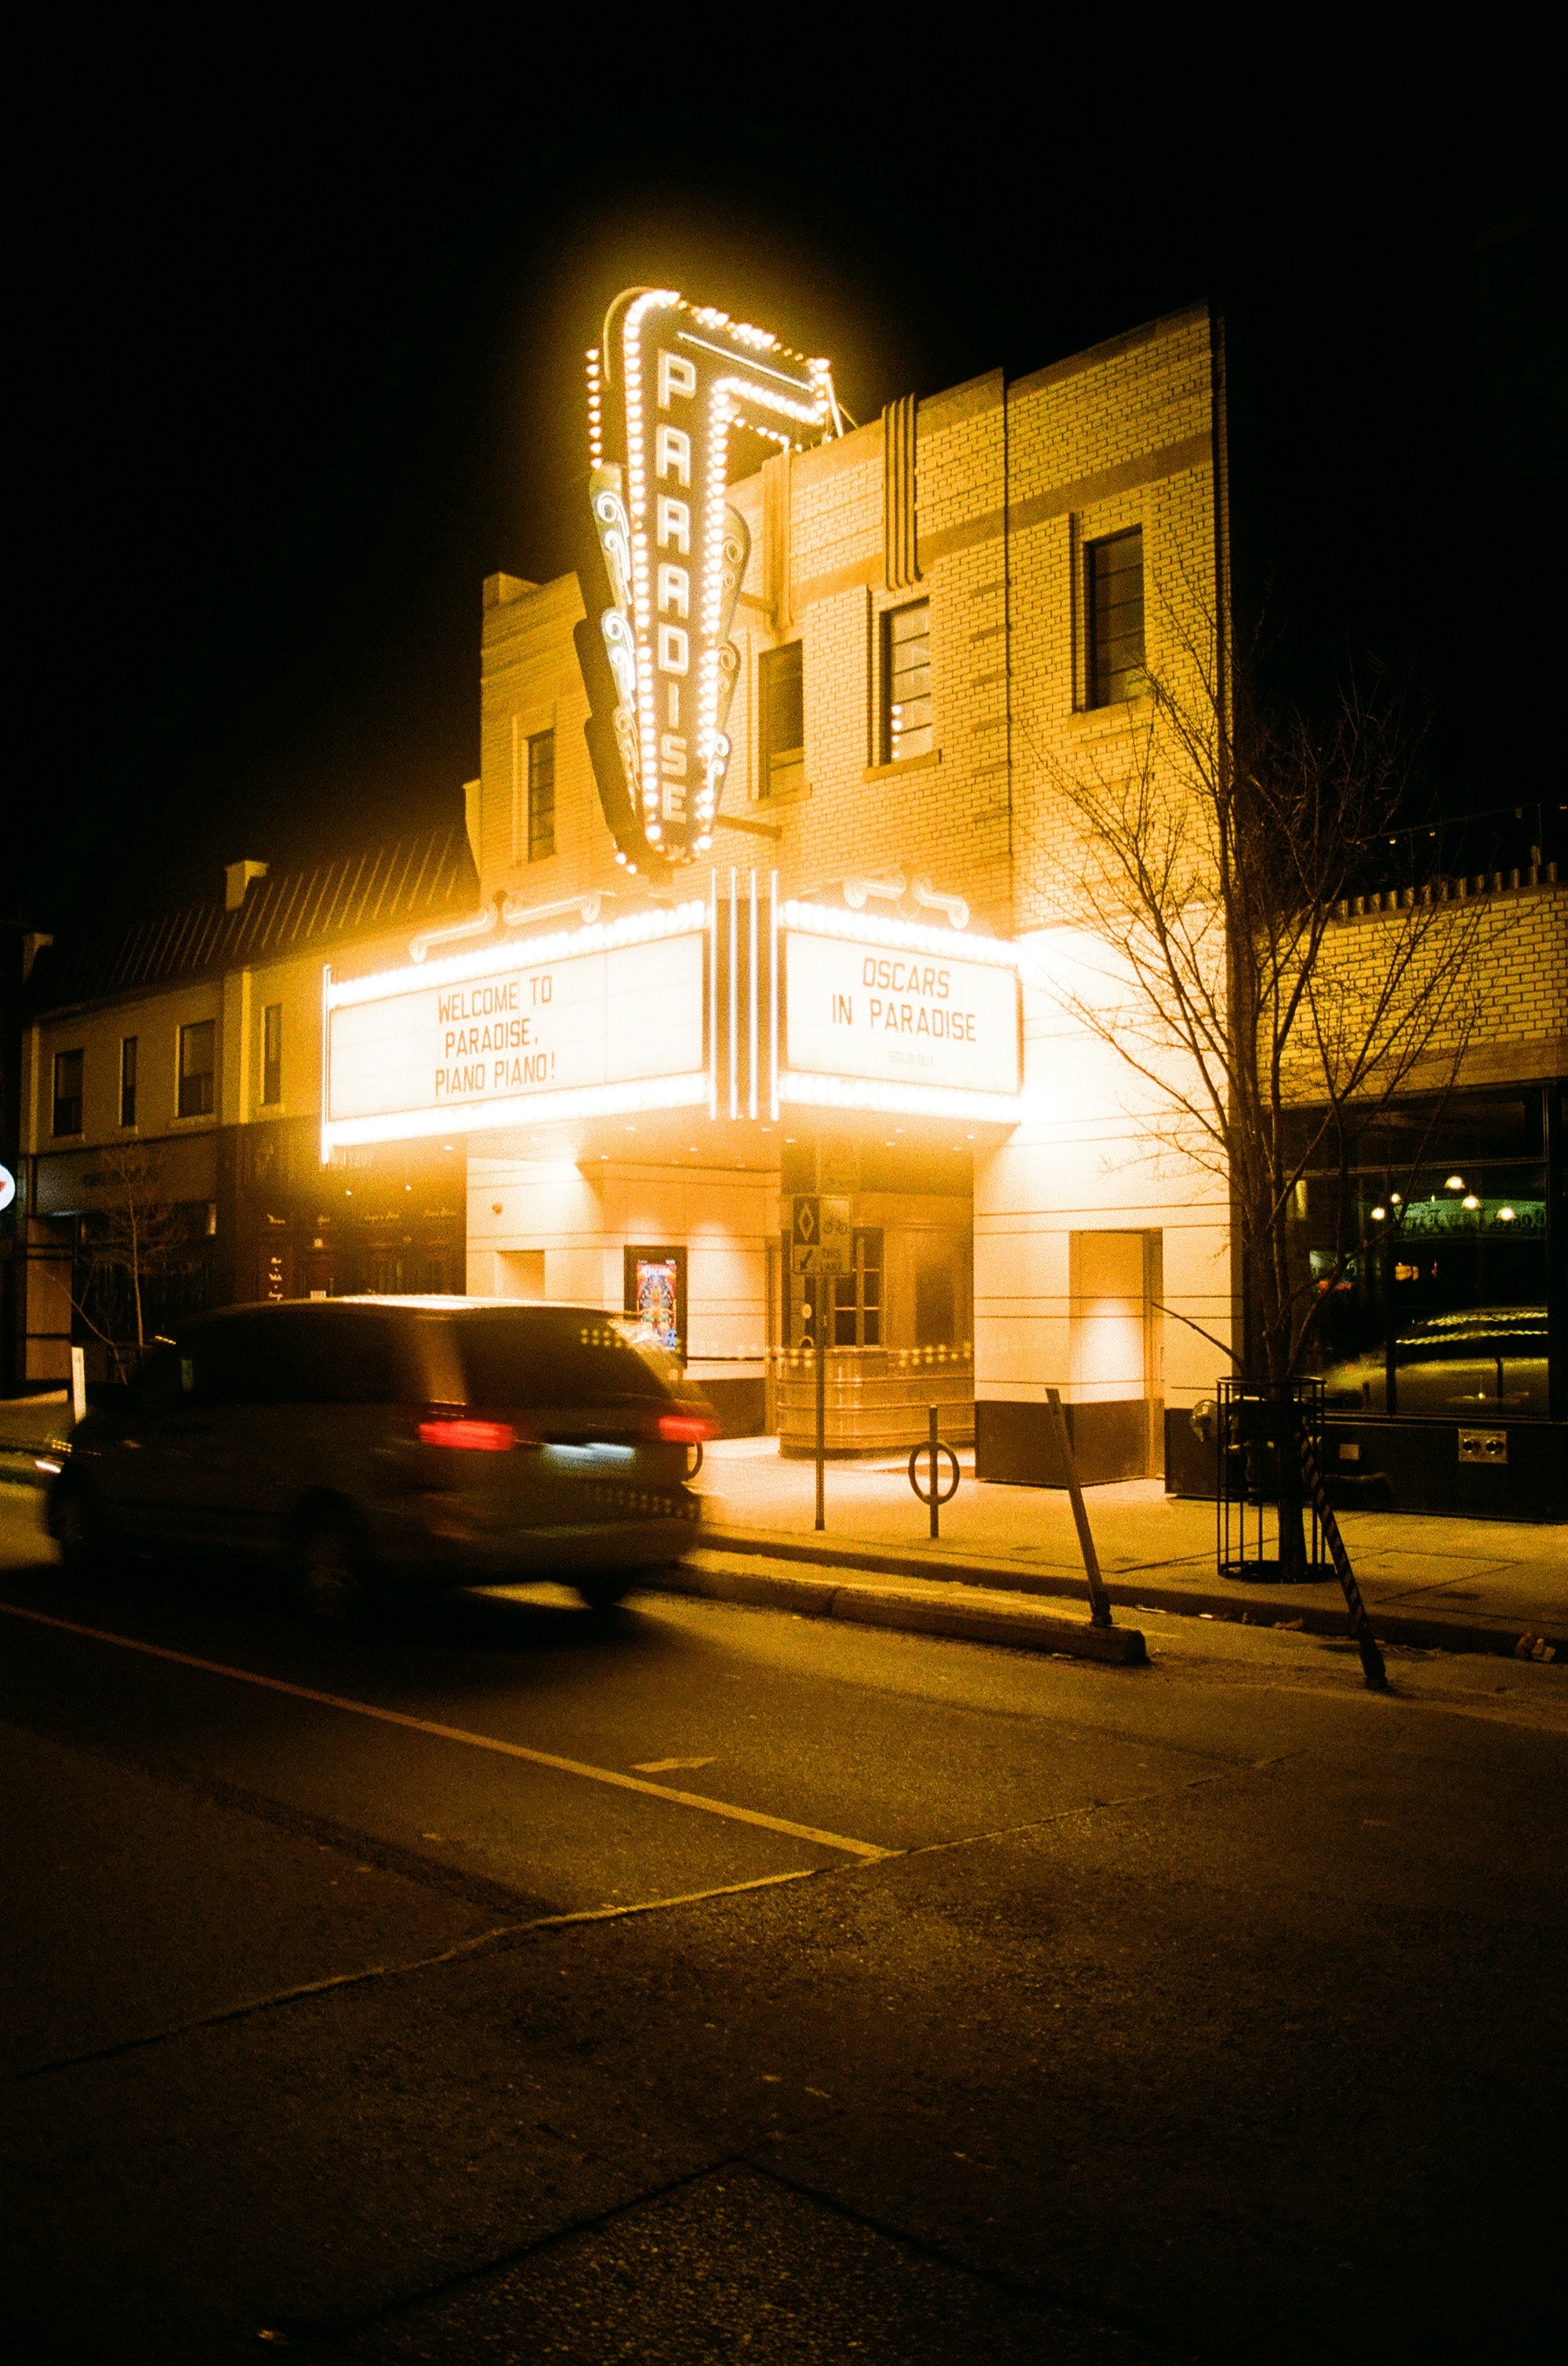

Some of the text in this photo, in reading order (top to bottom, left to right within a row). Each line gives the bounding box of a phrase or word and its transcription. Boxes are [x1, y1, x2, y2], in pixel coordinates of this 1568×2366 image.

[656, 351, 696, 823] PARADISE
[439, 976, 553, 1023] WELCOME TO
[862, 957, 950, 999] OSCARS
[445, 1018, 539, 1059] PARADISE,
[833, 994, 977, 1042] IN PARADISE
[434, 1052, 556, 1096] PIANO PIANO!
